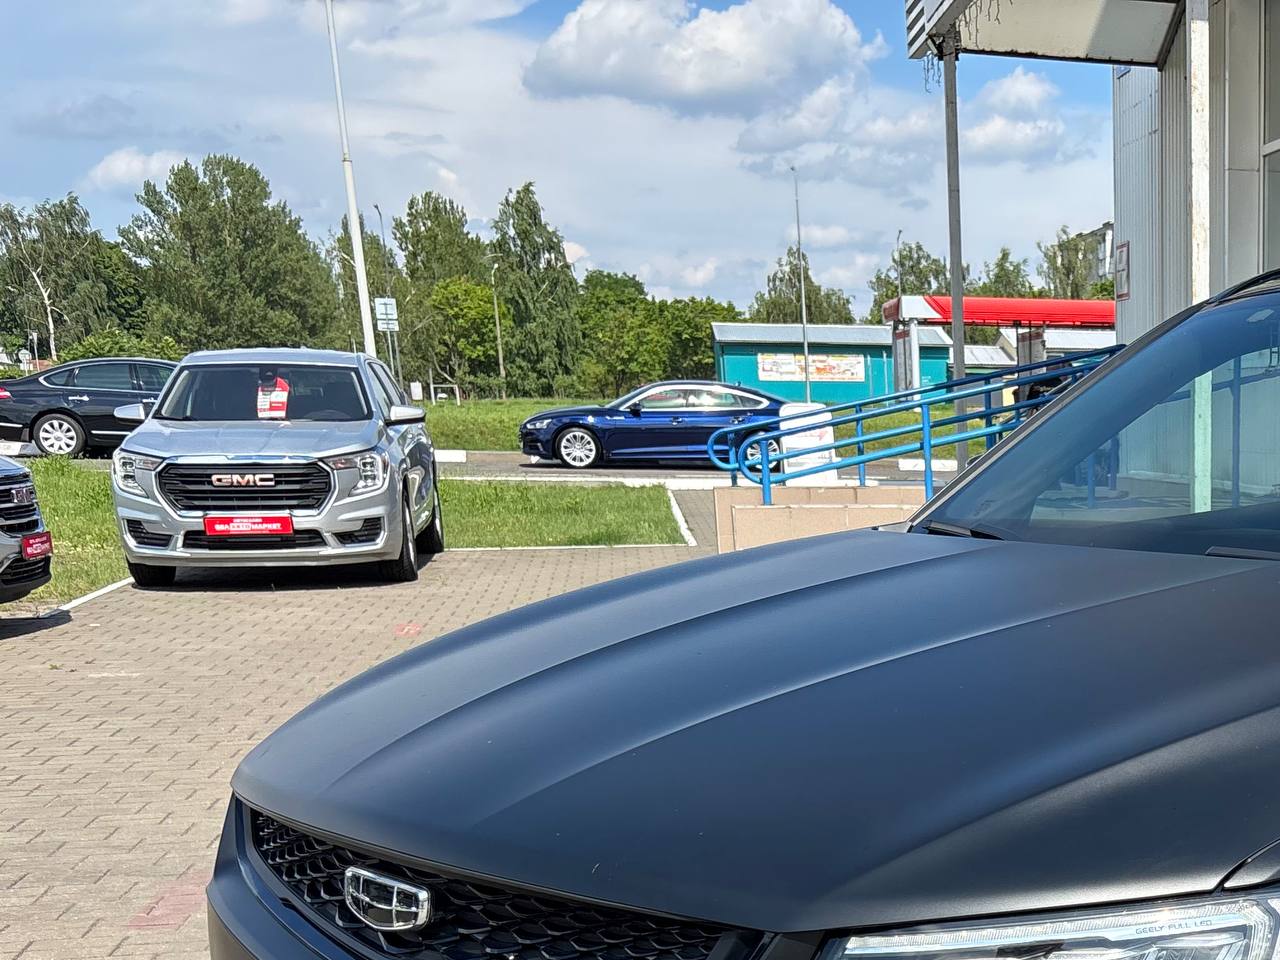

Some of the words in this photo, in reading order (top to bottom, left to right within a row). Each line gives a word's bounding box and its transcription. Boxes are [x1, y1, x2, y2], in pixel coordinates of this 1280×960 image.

[211, 474, 275, 486] GMC
[1135, 925, 1165, 935] GEELY
[1168, 921, 1191, 931] FULL
[1194, 919, 1213, 928] LED
